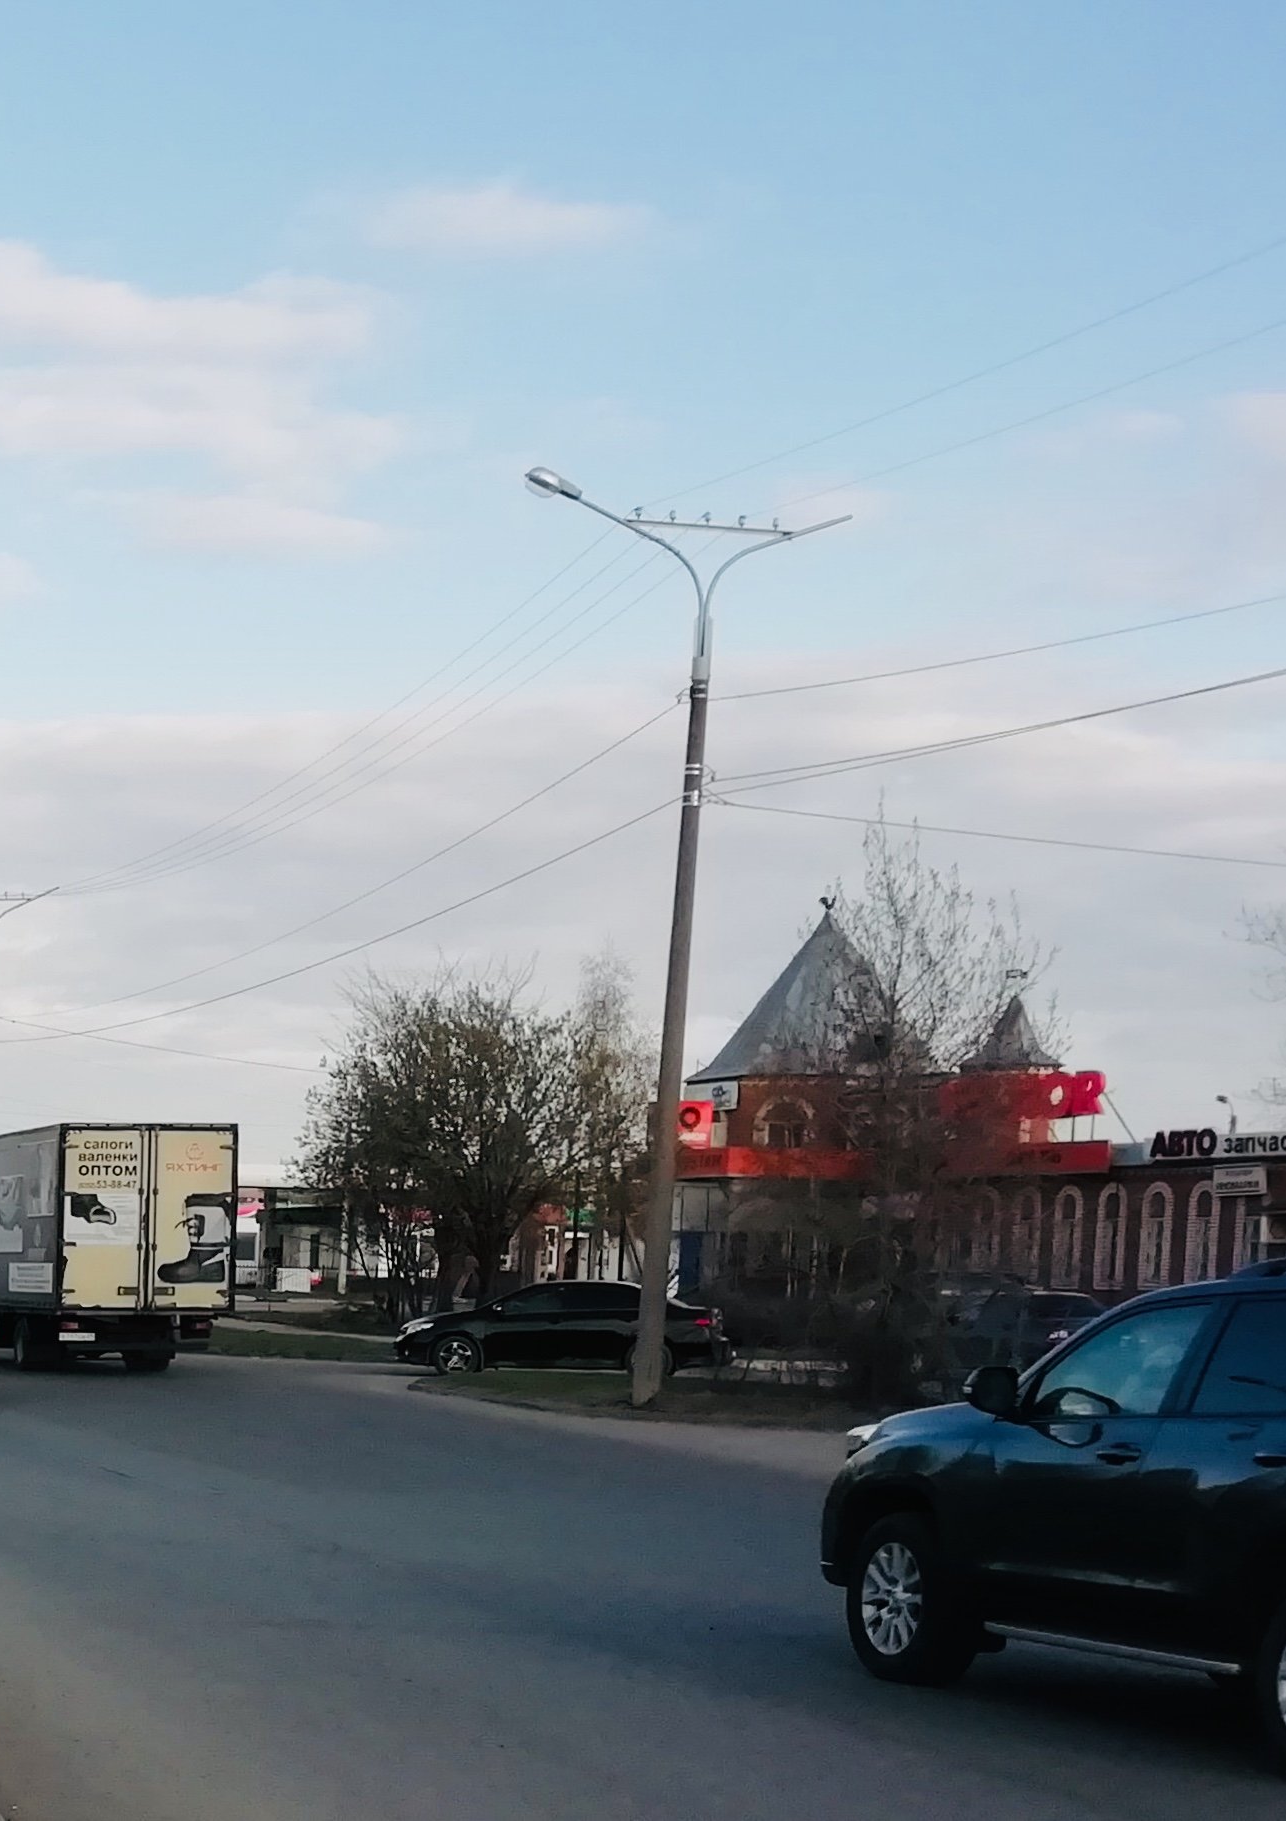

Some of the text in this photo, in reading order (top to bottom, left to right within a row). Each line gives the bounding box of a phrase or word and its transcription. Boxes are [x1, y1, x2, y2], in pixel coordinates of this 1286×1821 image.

[84, 1141, 133, 1150] сапоги
[1150, 1128, 1217, 1158] АВТО
[79, 1153, 138, 1162] валенки
[166, 1163, 223, 1172] ЯХТИНГ
